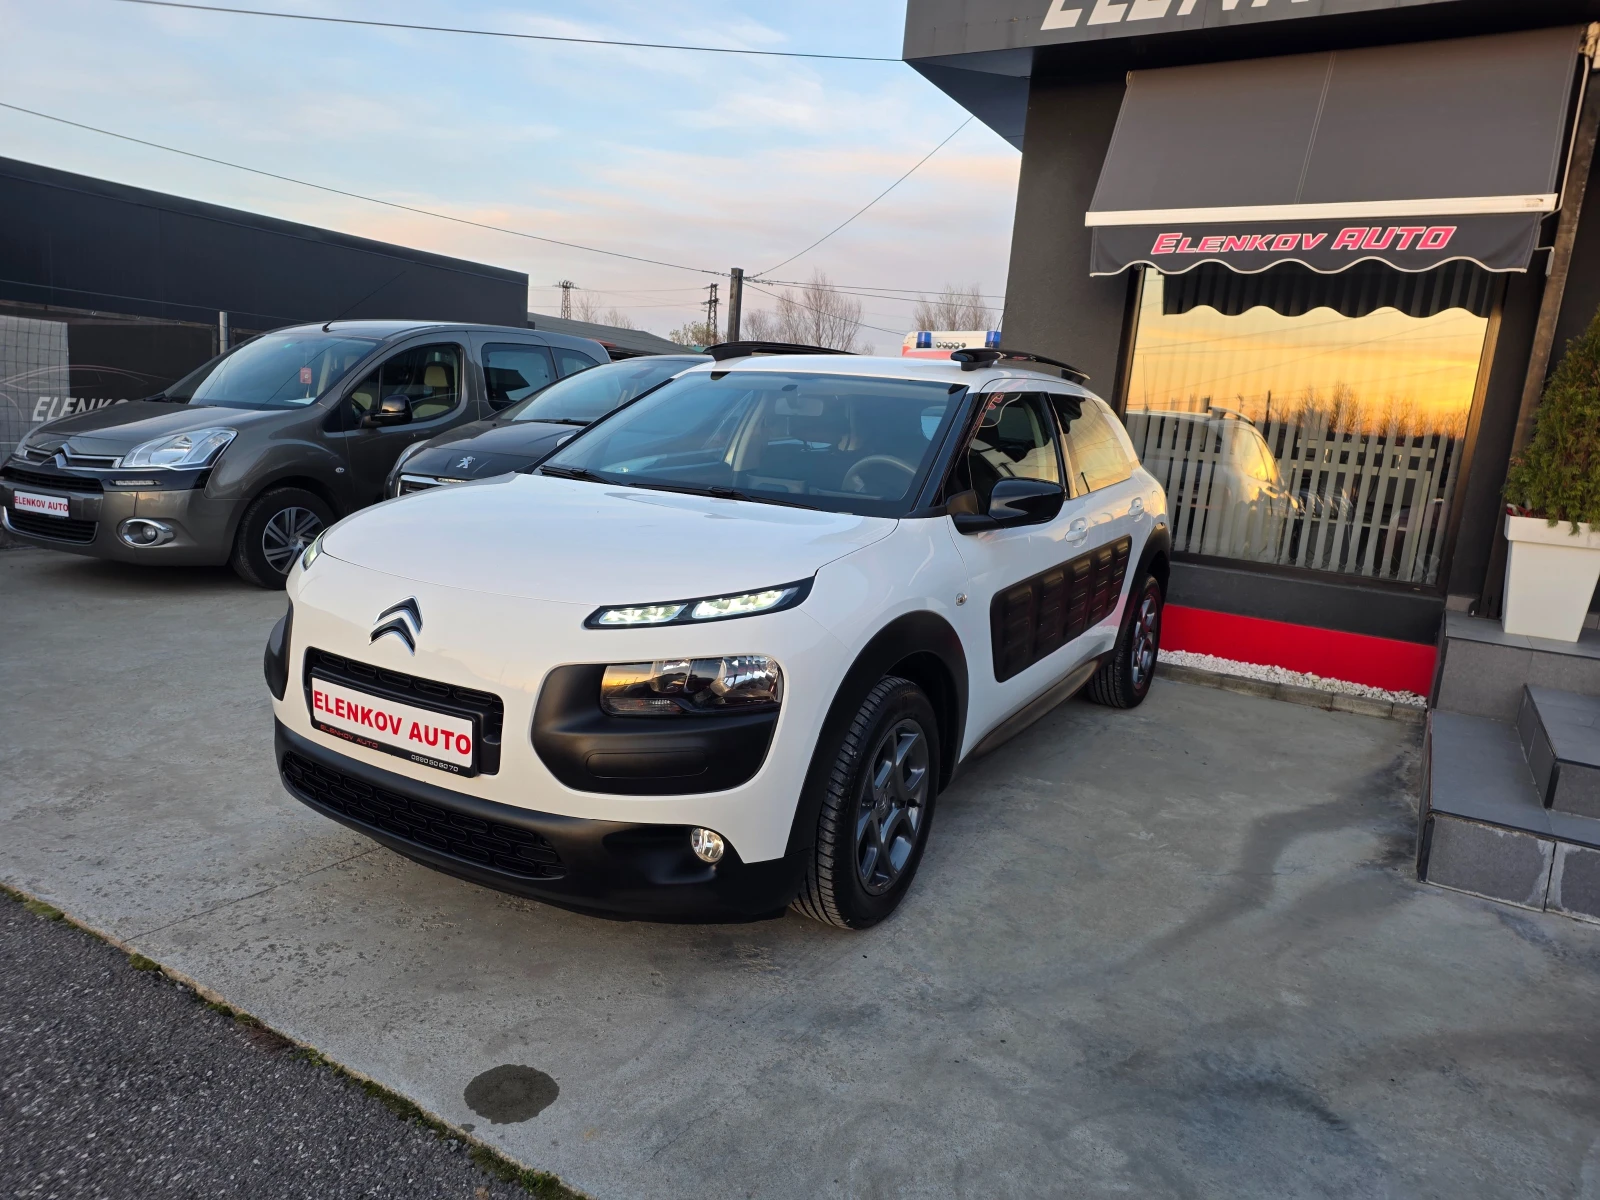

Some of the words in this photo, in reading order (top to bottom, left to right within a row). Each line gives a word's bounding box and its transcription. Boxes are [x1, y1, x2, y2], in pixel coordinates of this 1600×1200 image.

[1151, 232, 1328, 255] ELENKOV
[1331, 226, 1457, 250] AUTO
[14, 496, 46, 509] ELENKOV
[47, 501, 69, 512] AUTO
[313, 690, 402, 736] ELENKOV
[408, 721, 471, 755] AUTO
[320, 724, 354, 740] ELENKOV
[356, 737, 379, 749] AUTO
